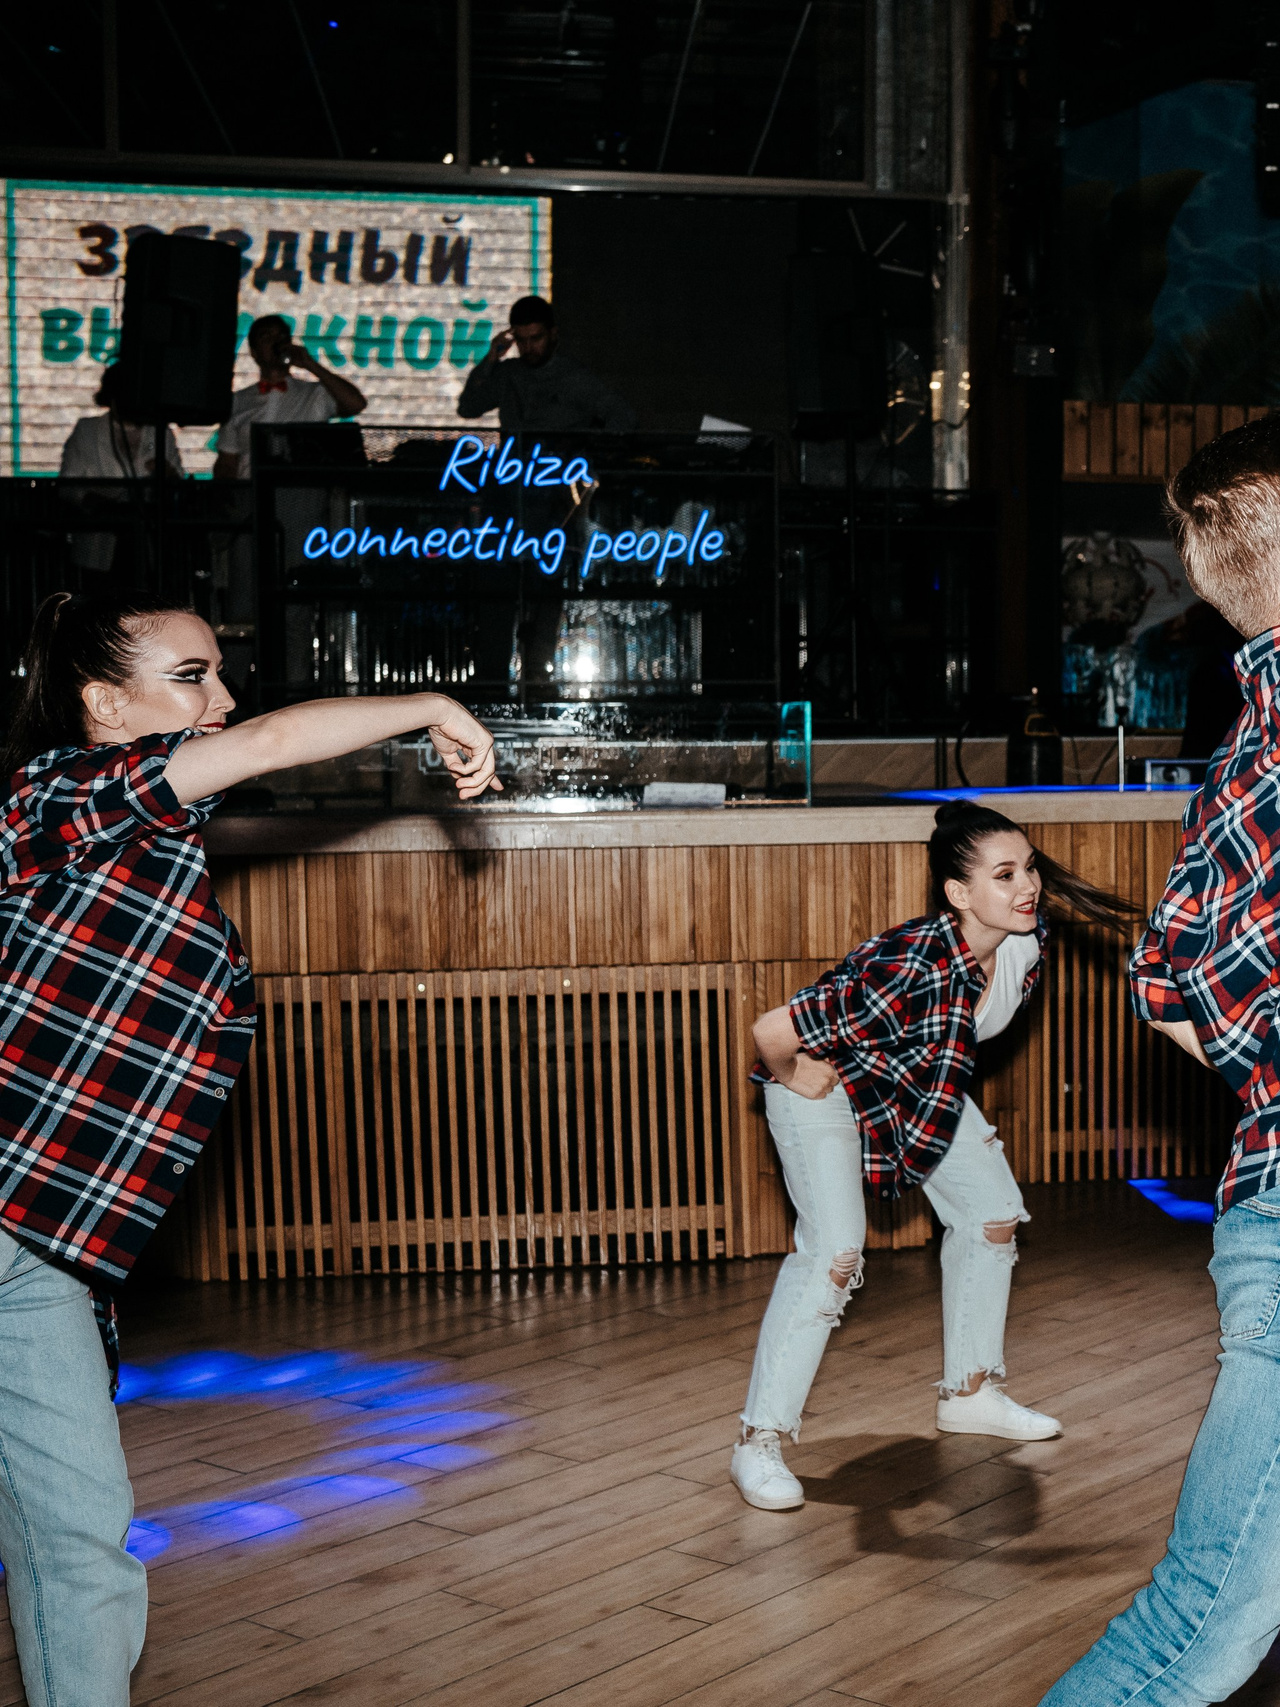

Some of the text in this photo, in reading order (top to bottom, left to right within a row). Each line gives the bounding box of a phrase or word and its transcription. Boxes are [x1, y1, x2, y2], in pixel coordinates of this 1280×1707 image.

[76, 213, 473, 294] ЗДНЫЙ
[40, 298, 494, 371] ВКНОЙ
[439, 434, 596, 493] Ribiza
[303, 509, 726, 578] connecting people
